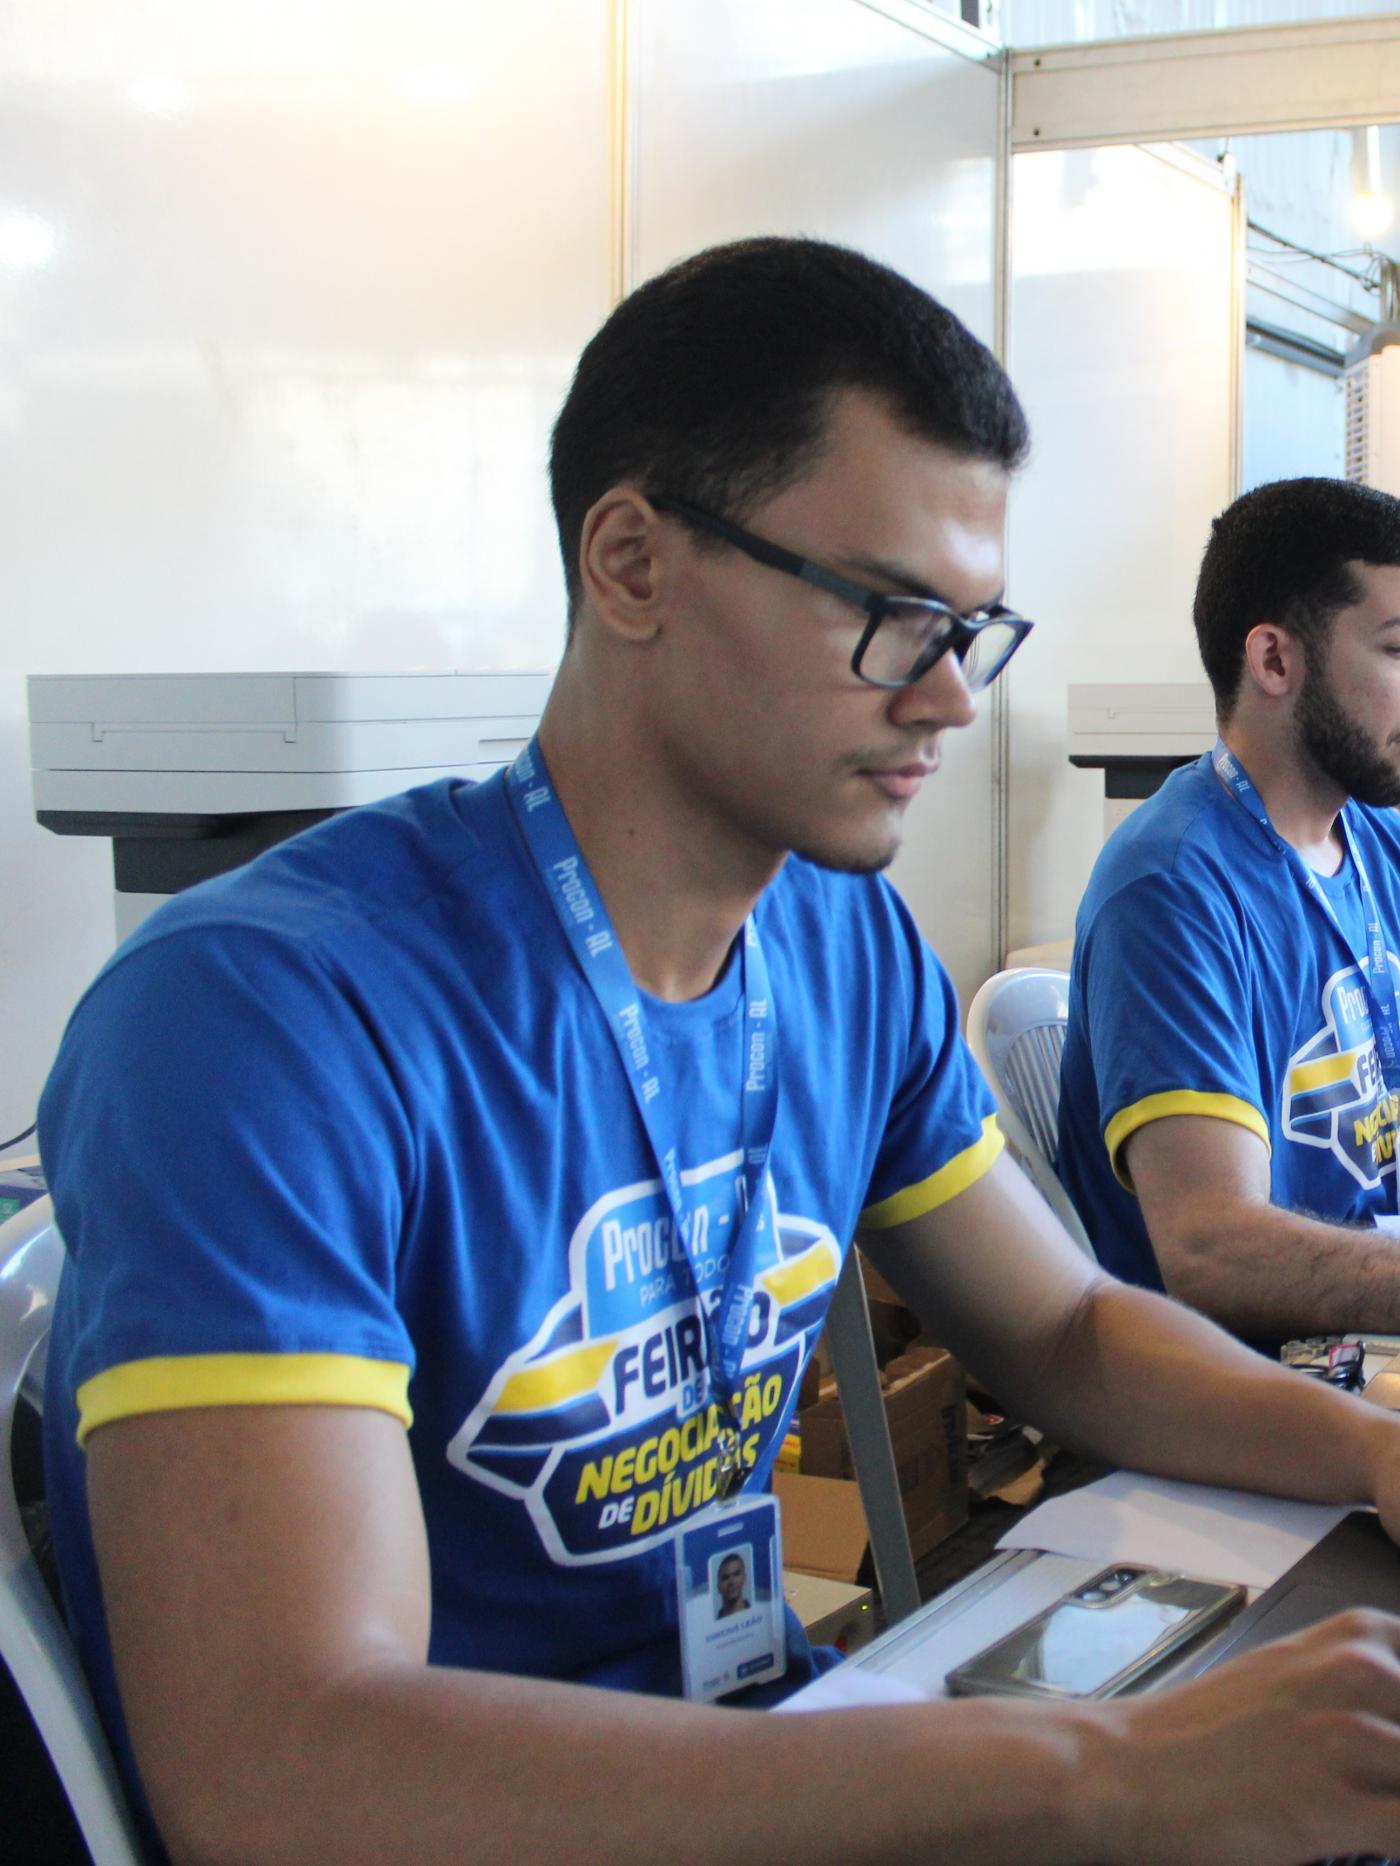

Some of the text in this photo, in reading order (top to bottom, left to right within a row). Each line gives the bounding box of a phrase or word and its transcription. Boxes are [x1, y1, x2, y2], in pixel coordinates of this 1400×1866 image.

[523, 786, 551, 812] AL
[1236, 780, 1250, 792] AL
[553, 856, 594, 924] Procon
[585, 929, 613, 958] AL
[1373, 940, 1384, 973] Procon
[749, 997, 768, 1018] AL
[619, 1002, 649, 1071] Procon
[641, 1075, 661, 1104] AL
[745, 1031, 766, 1091] Procon
[601, 1203, 709, 1292] Procon
[612, 1288, 771, 1416] FEIRO
[575, 1373, 783, 1504] NEGOCIAÃO
[598, 1496, 634, 1530] DE
[630, 1432, 760, 1536] DÍVIDS
